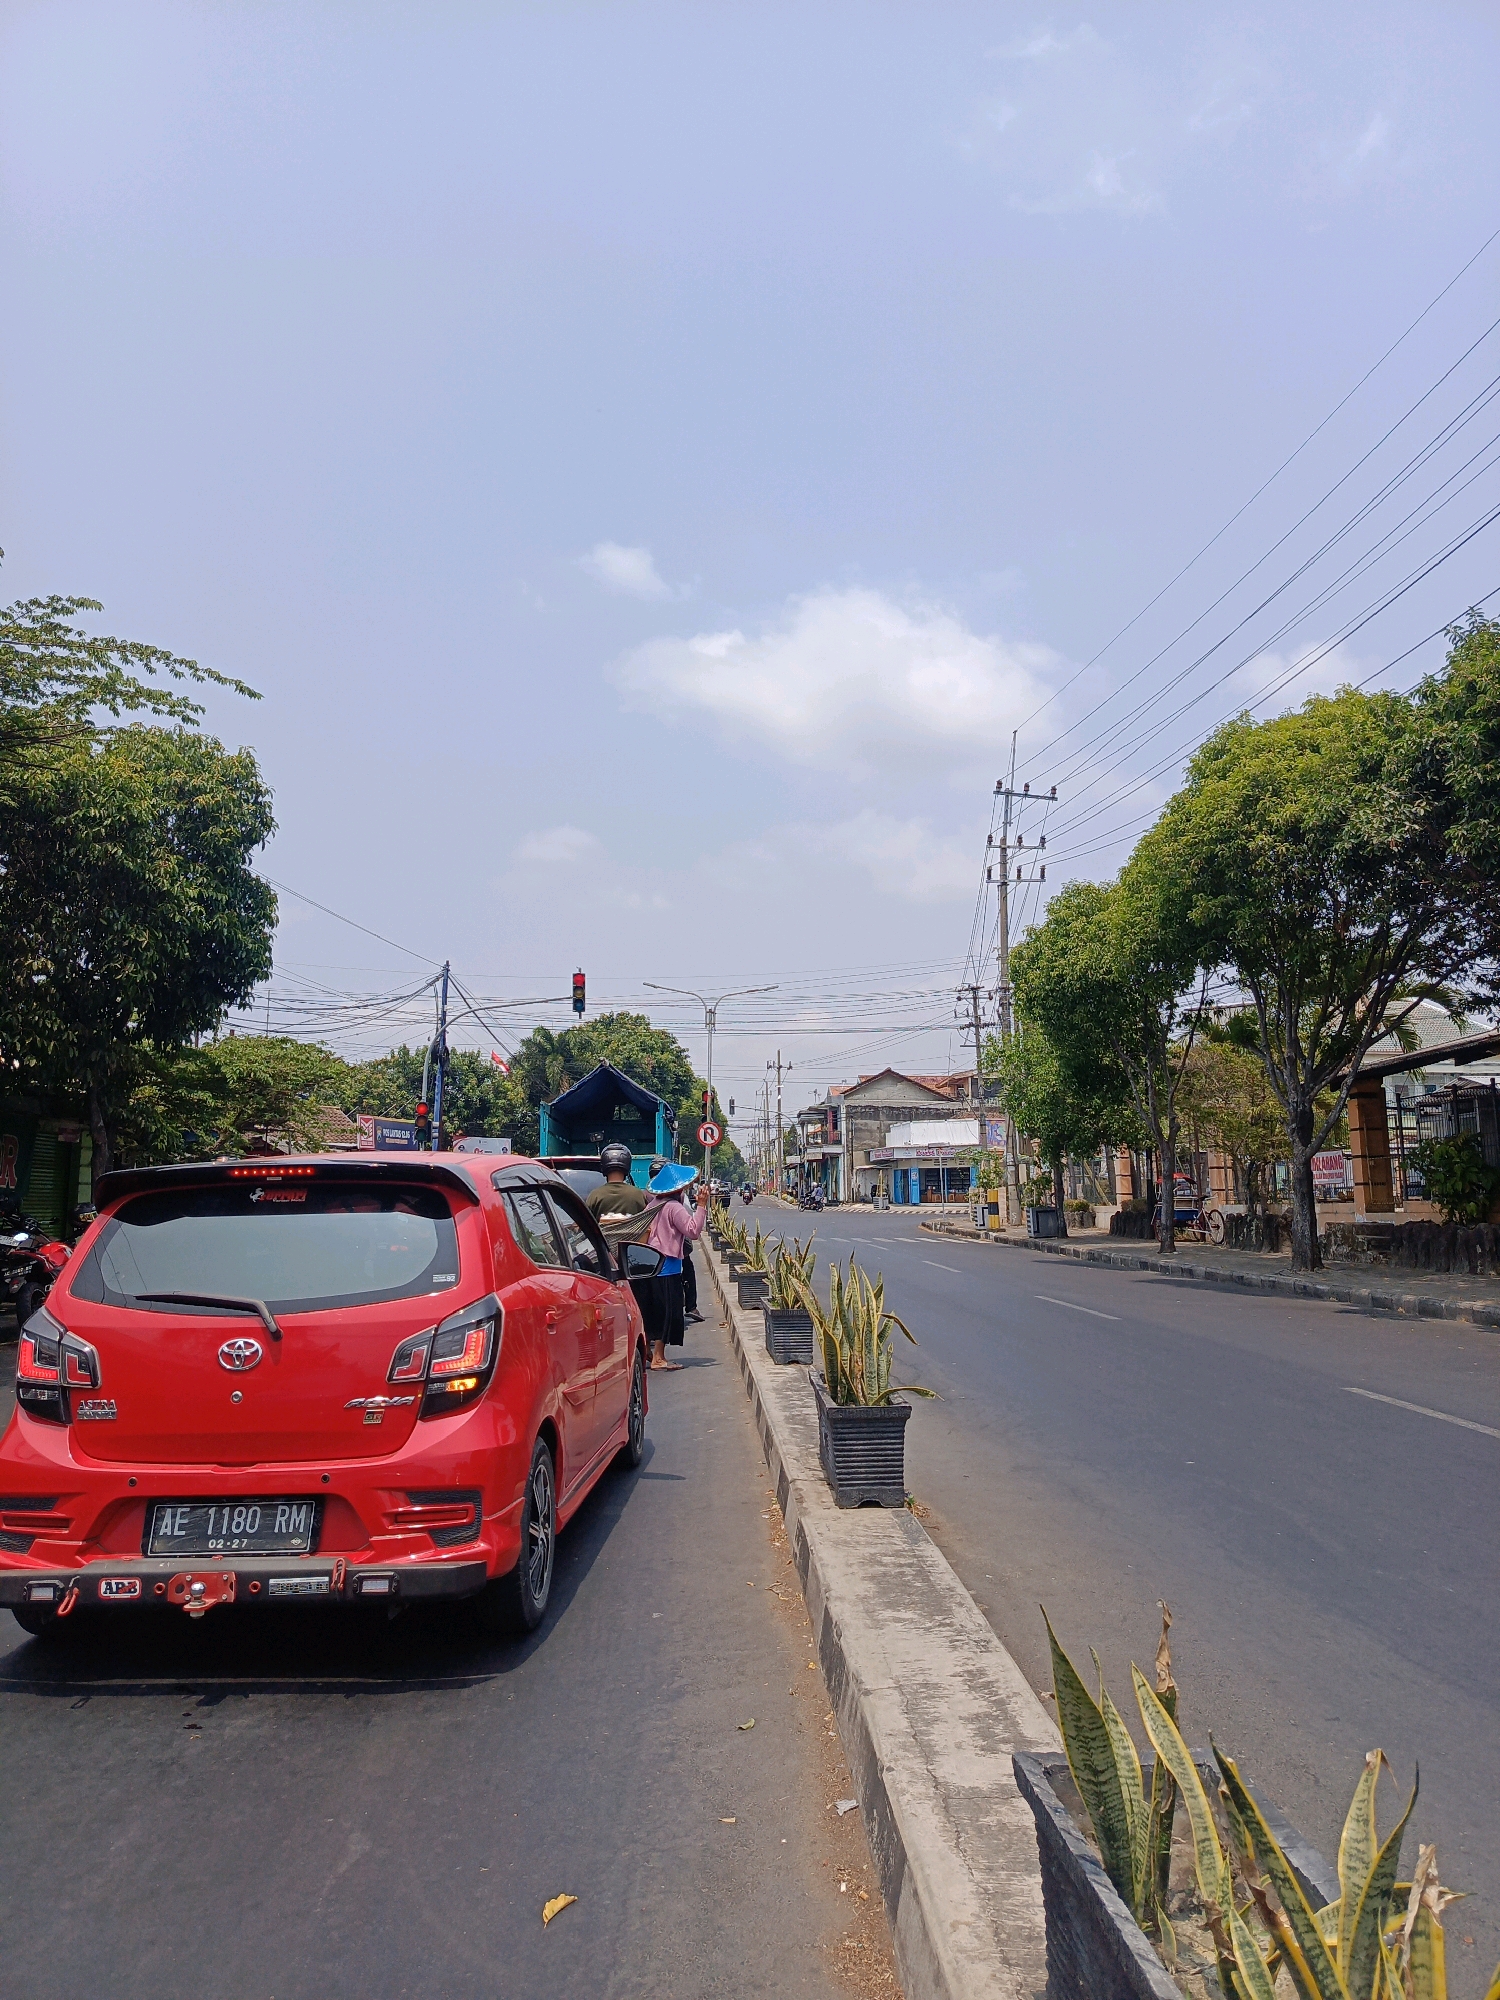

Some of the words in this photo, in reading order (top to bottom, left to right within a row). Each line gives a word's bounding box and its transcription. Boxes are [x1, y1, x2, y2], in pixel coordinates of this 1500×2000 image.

[78, 1399, 117, 1411] ASTRA
[159, 1507, 191, 1536] AE
[207, 1505, 261, 1535] 1180
[274, 1504, 307, 1533] RM
